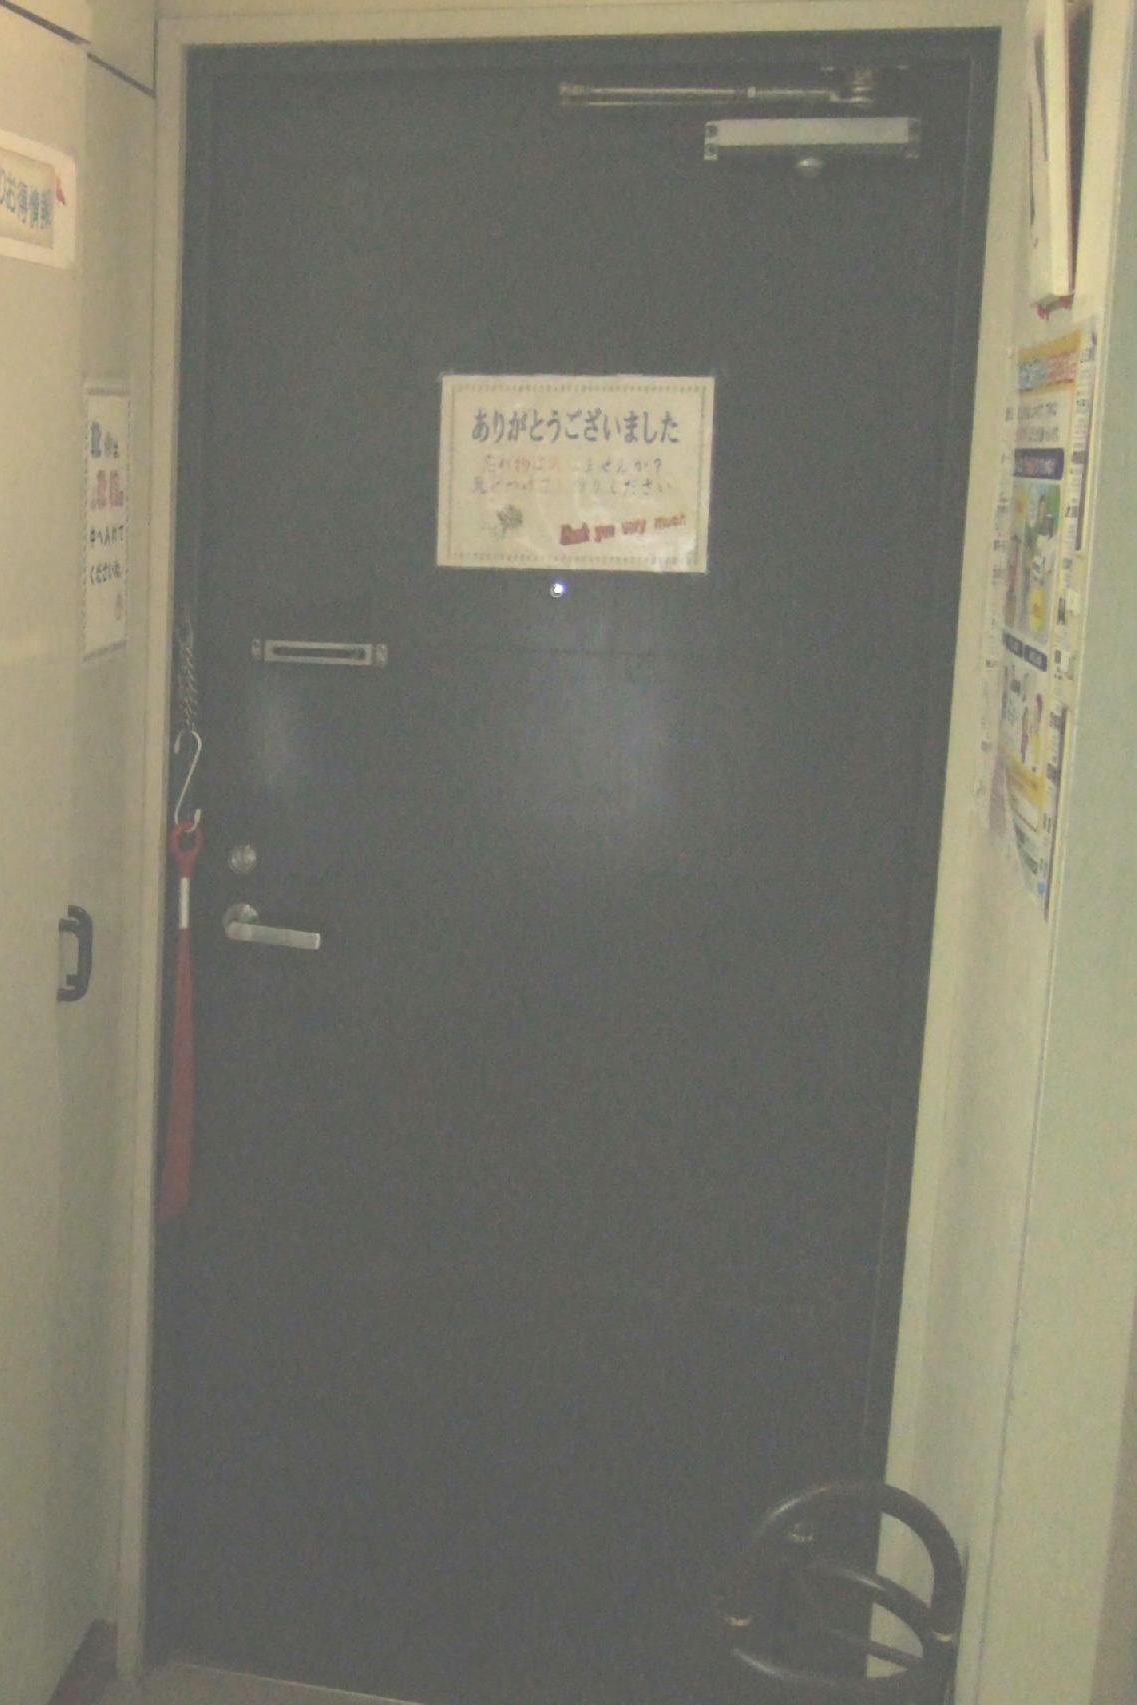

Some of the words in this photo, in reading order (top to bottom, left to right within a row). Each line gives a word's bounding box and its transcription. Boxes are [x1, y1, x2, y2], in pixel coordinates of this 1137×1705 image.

[471, 407, 680, 444] ありがとうございました
